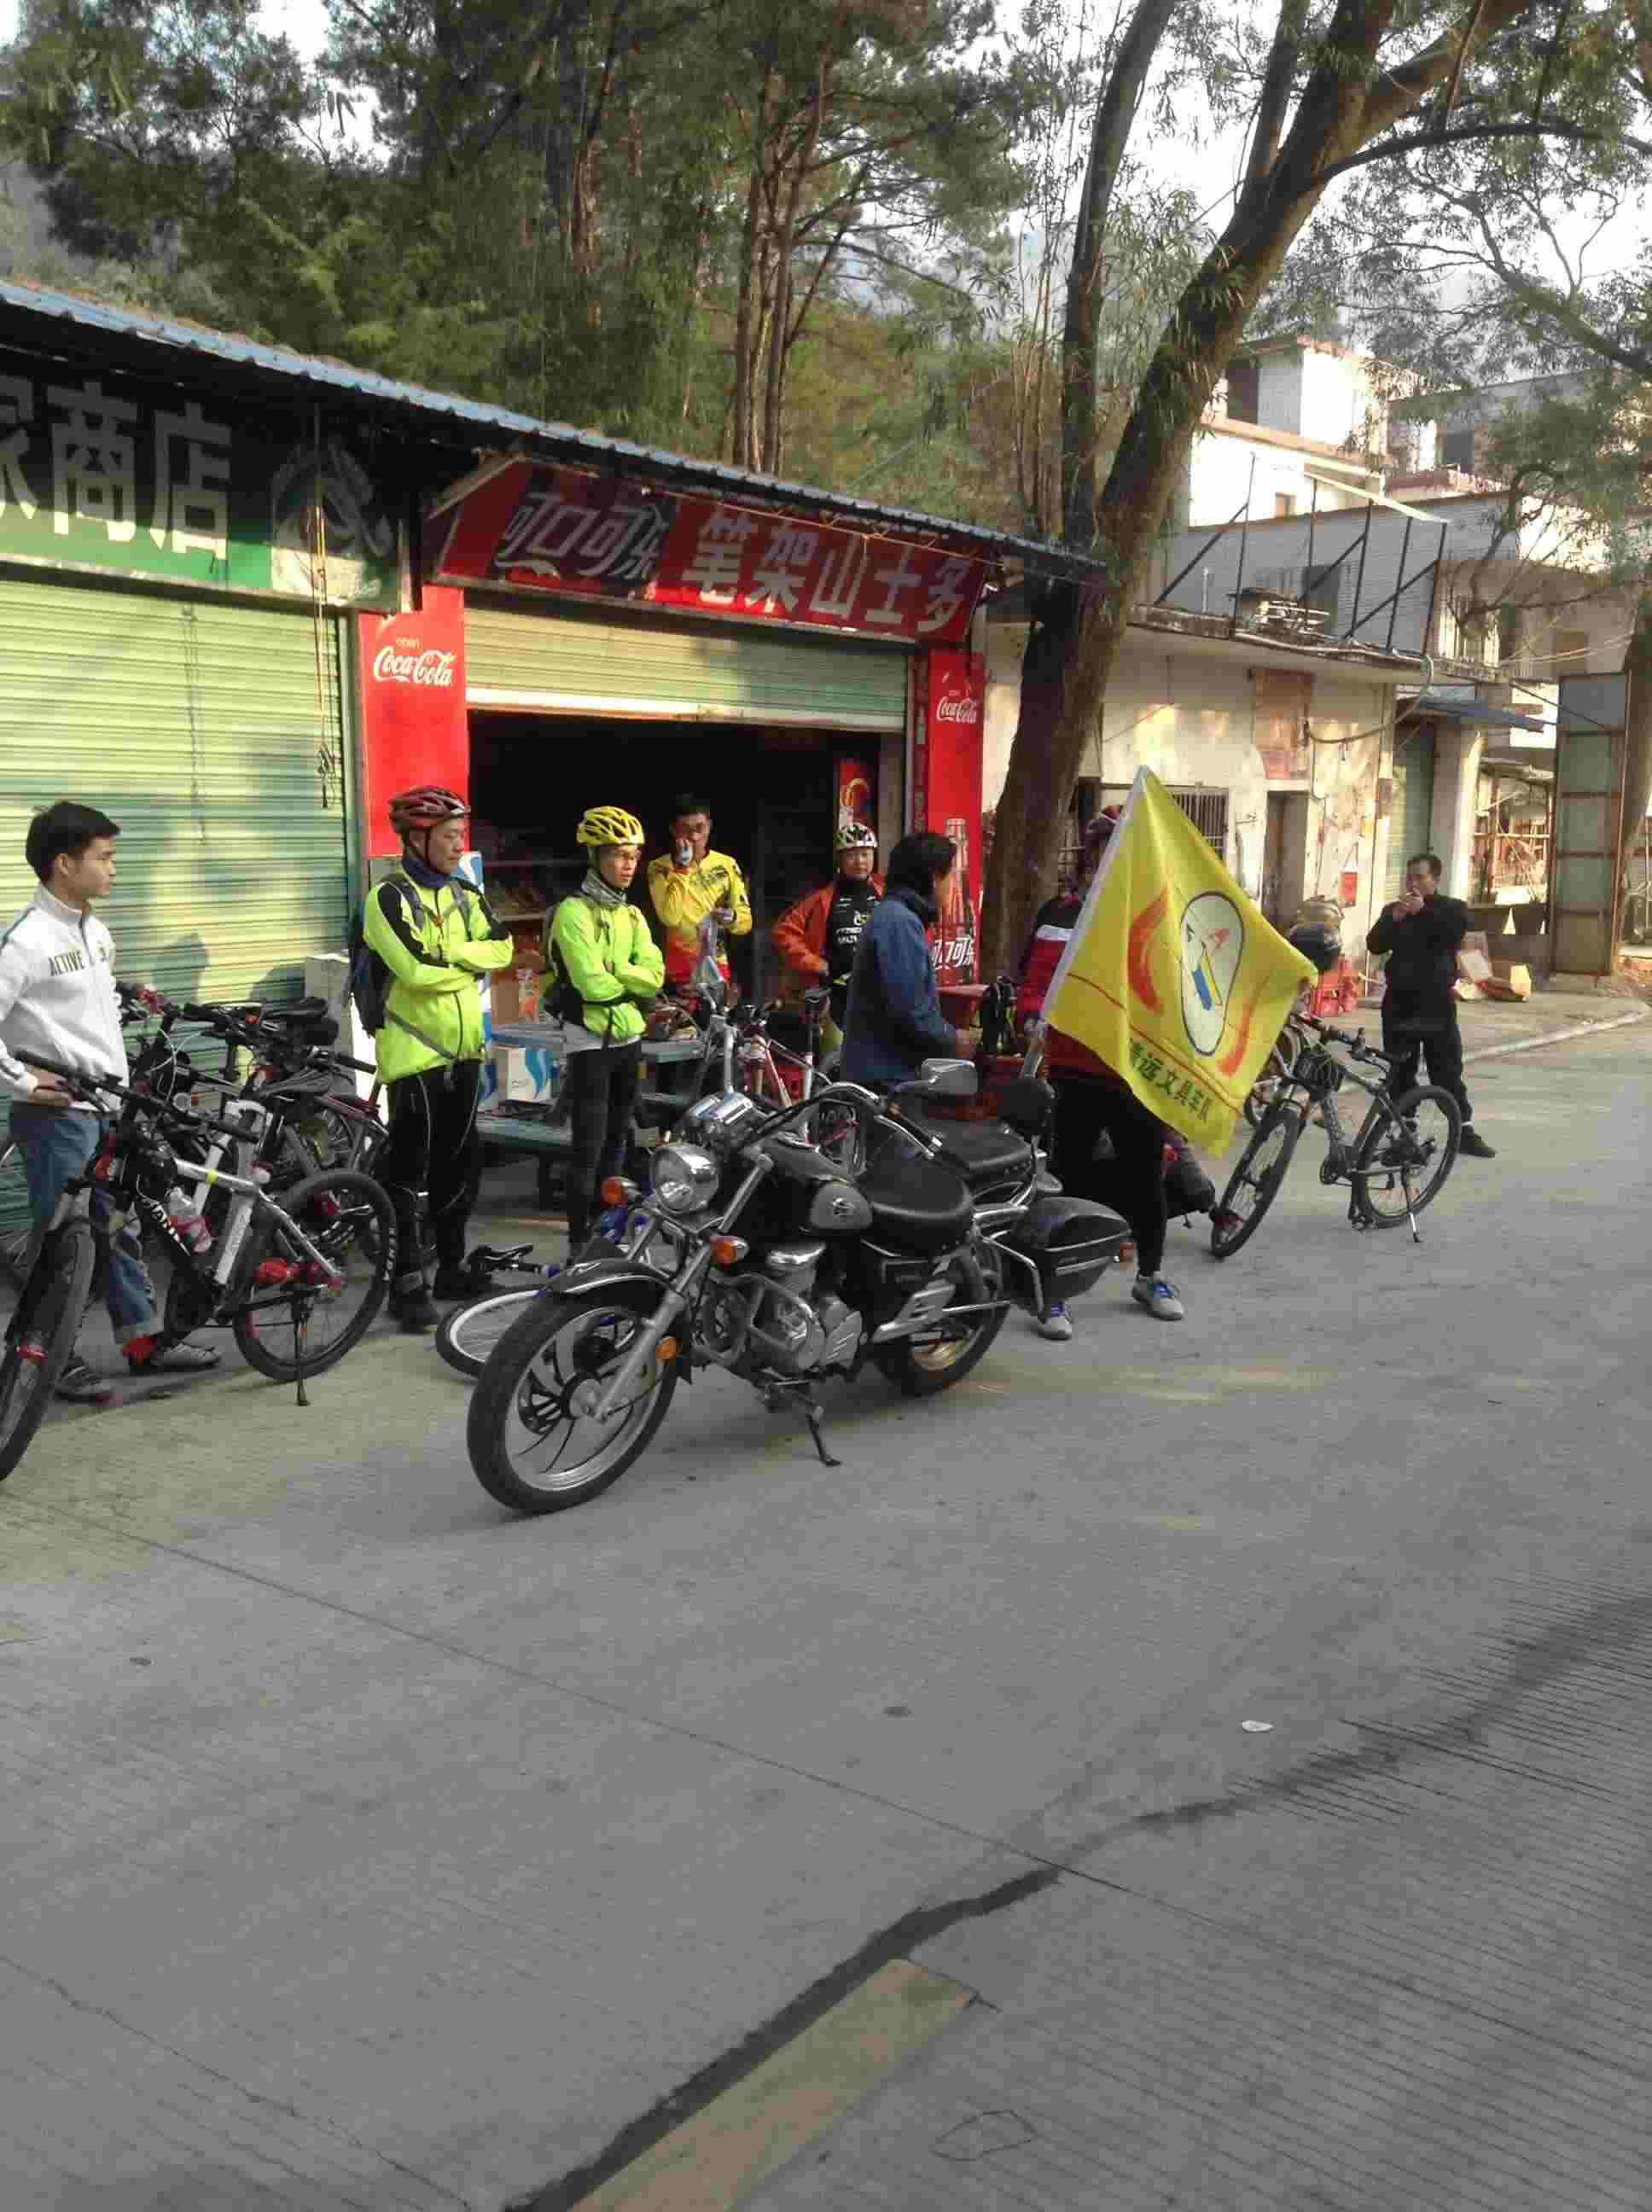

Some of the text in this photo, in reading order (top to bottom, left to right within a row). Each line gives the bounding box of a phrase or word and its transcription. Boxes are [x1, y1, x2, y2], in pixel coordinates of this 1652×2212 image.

[682, 504, 971, 632] 笔架山士多
